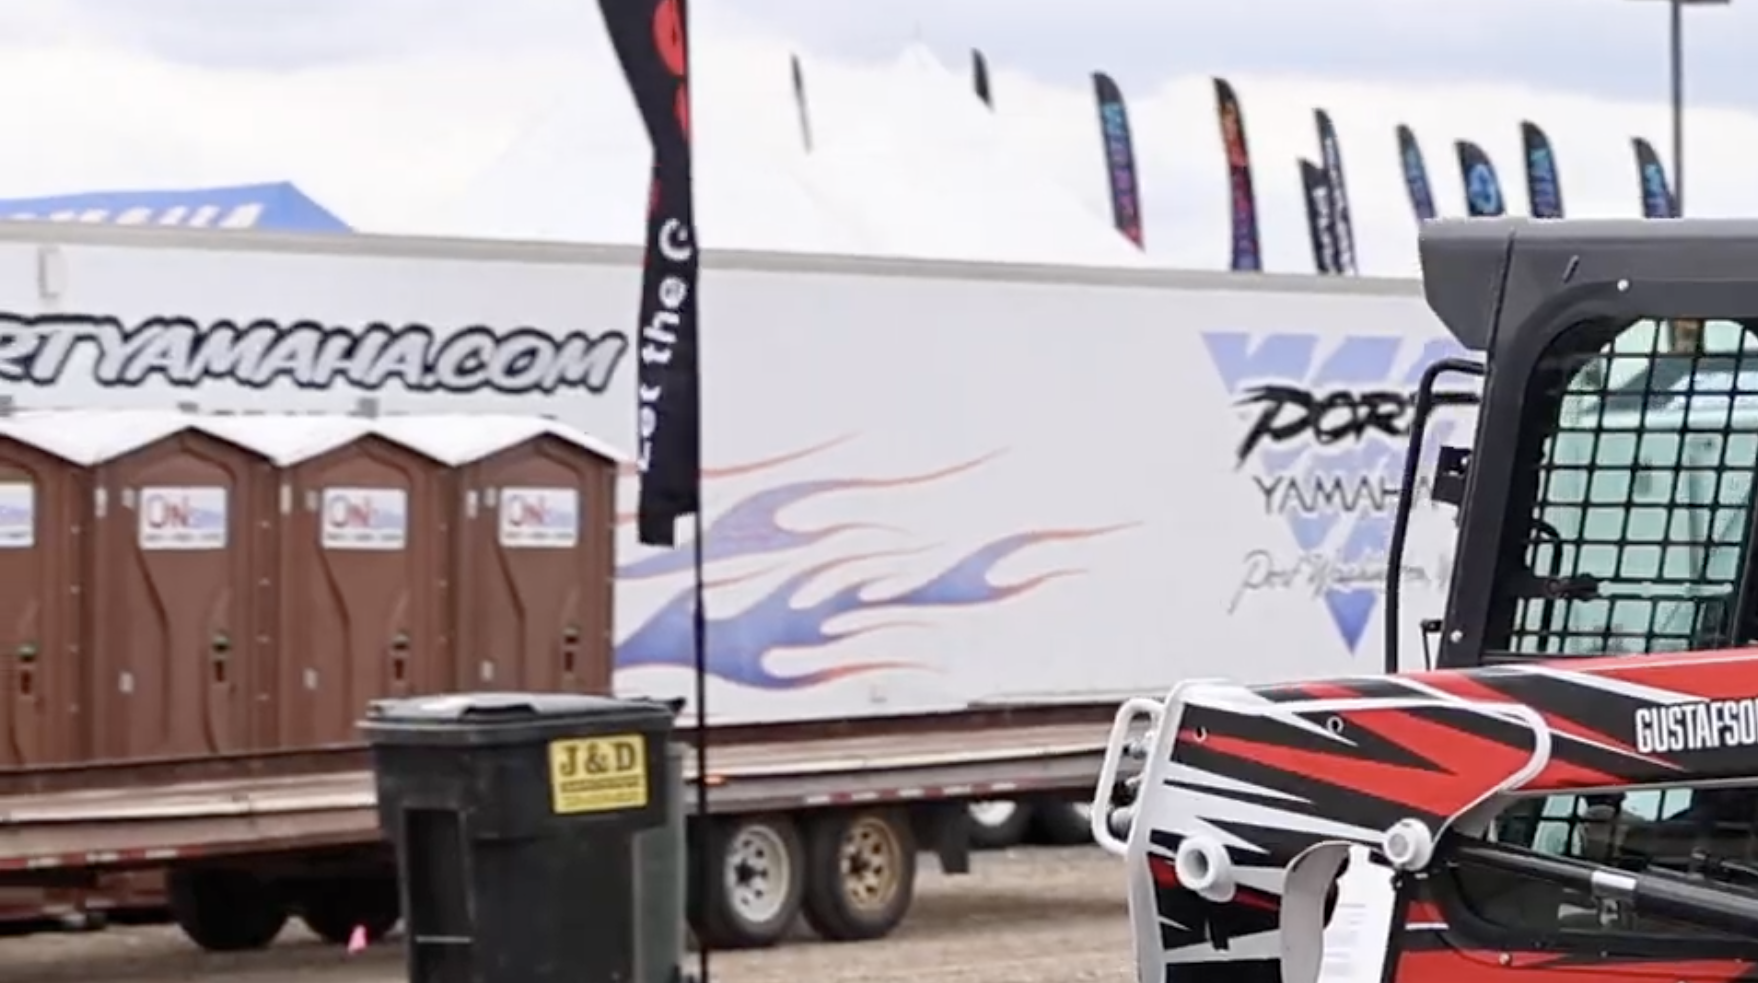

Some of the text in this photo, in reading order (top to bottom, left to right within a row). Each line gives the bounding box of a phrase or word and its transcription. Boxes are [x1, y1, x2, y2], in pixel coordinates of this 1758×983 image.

[642, 276, 687, 365] the
[560, 741, 637, 777] J & D
